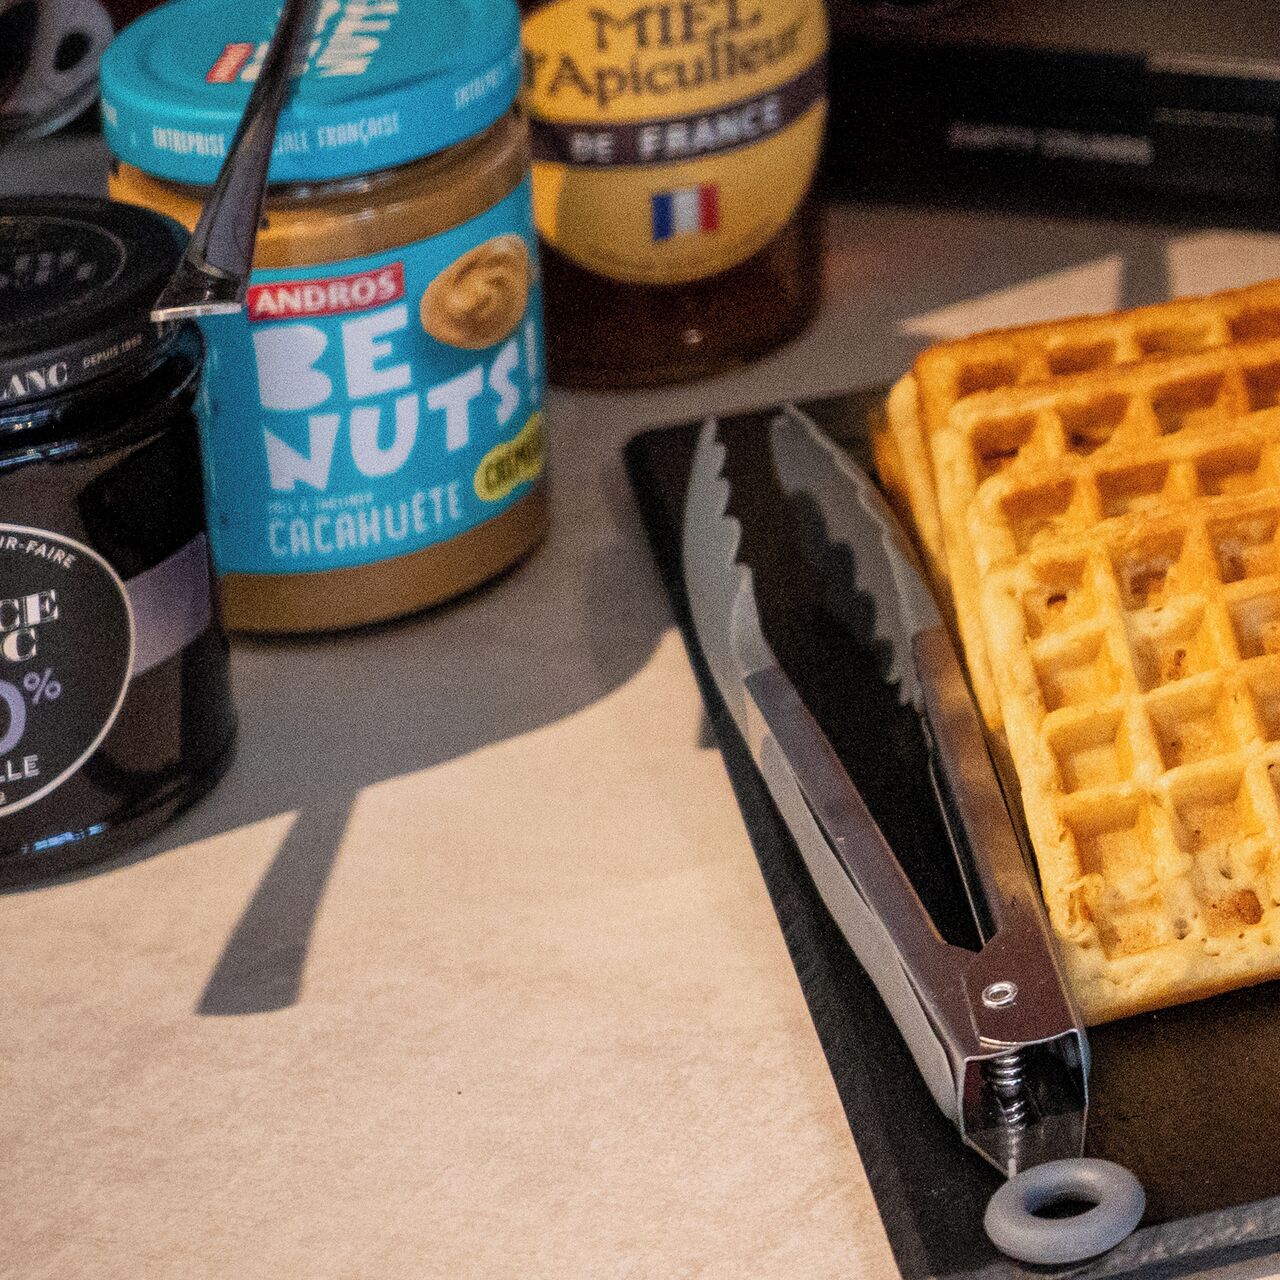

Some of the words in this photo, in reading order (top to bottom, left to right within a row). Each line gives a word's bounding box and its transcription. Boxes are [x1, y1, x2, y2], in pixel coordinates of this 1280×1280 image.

[570, 129, 617, 163] DE
[255, 271, 397, 316] ANDROS
[252, 303, 411, 411] BE
[0, 361, 68, 400] ANC
